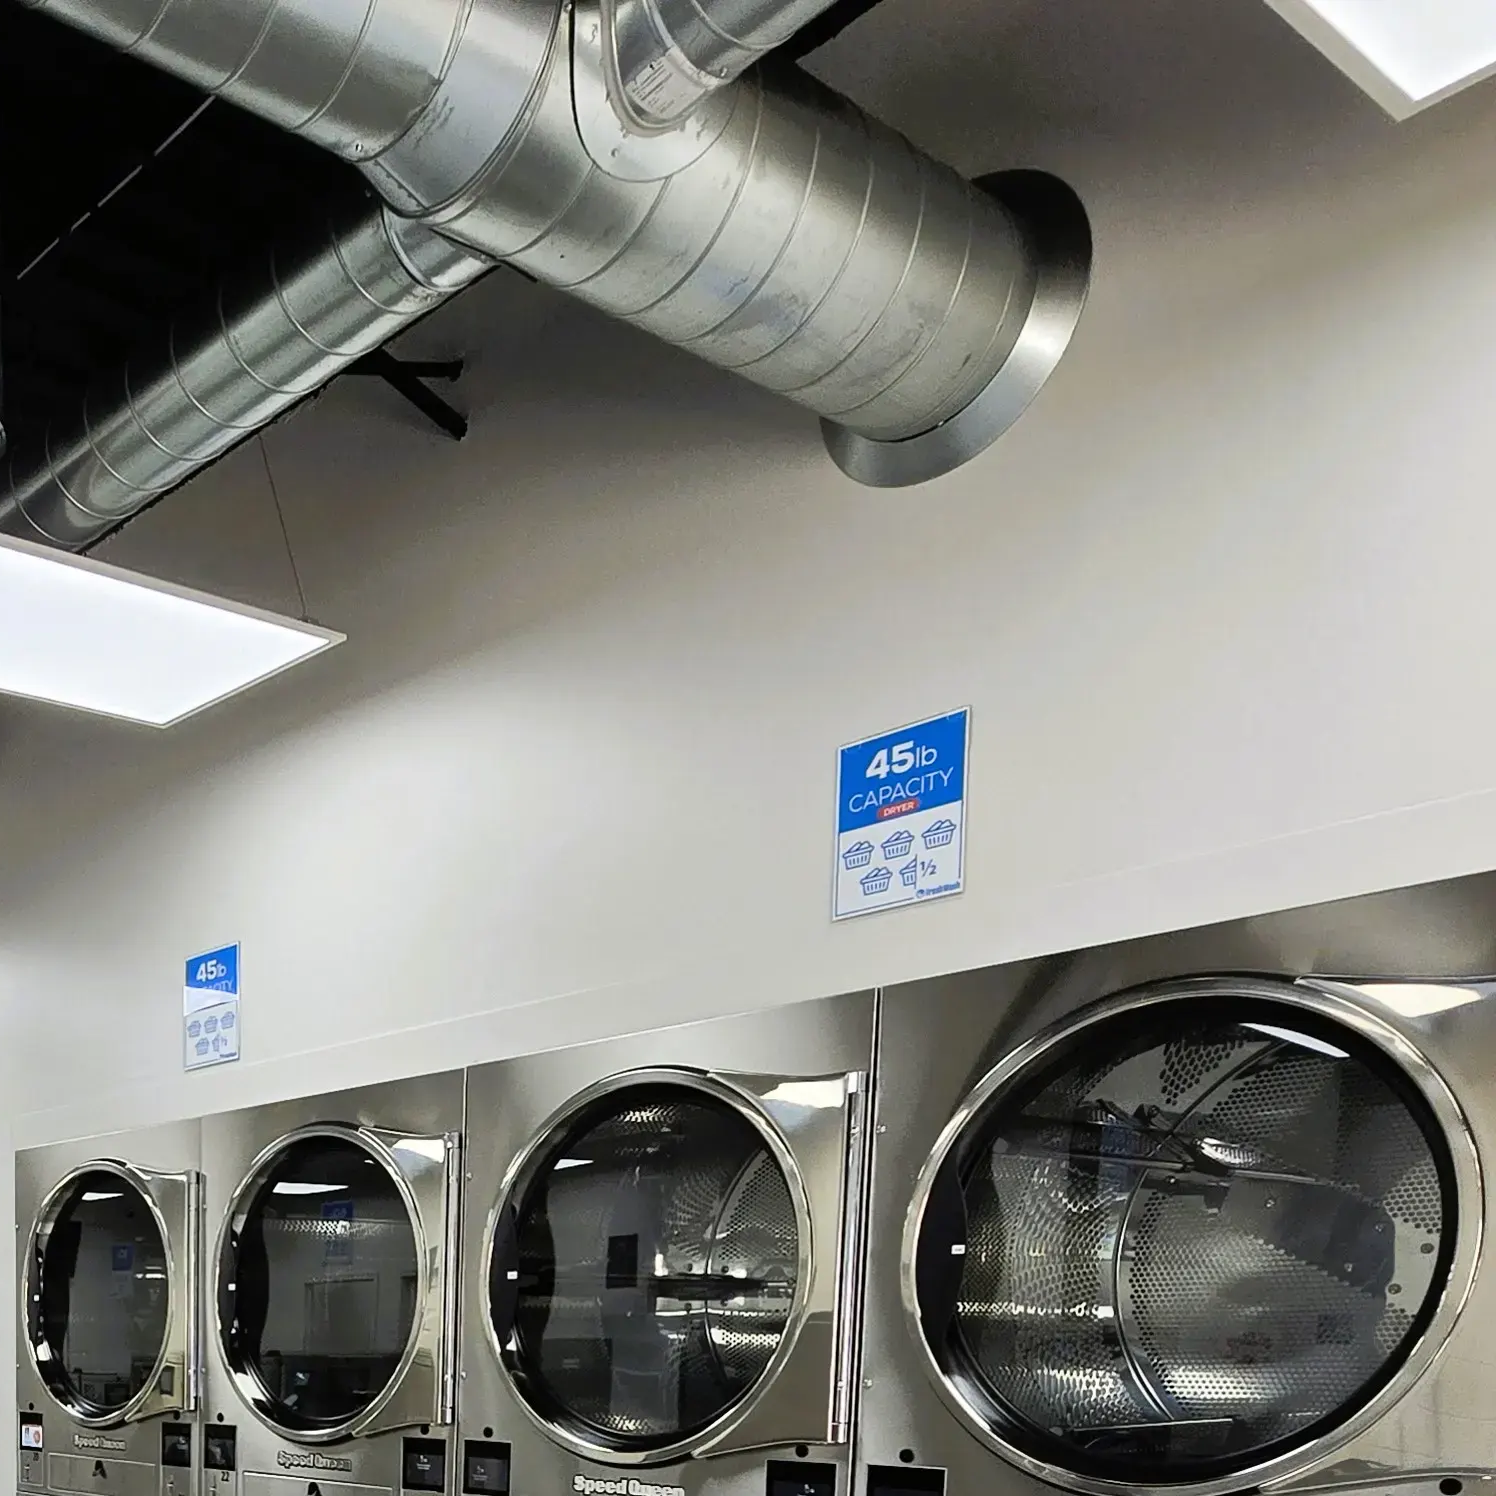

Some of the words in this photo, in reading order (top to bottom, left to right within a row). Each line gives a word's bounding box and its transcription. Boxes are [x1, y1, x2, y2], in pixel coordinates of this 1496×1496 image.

[866, 740, 938, 779] 45lb
[849, 766, 954, 813] CAPACITY
[277, 1450, 314, 1469] Speed
[572, 1474, 628, 1496] Speed
